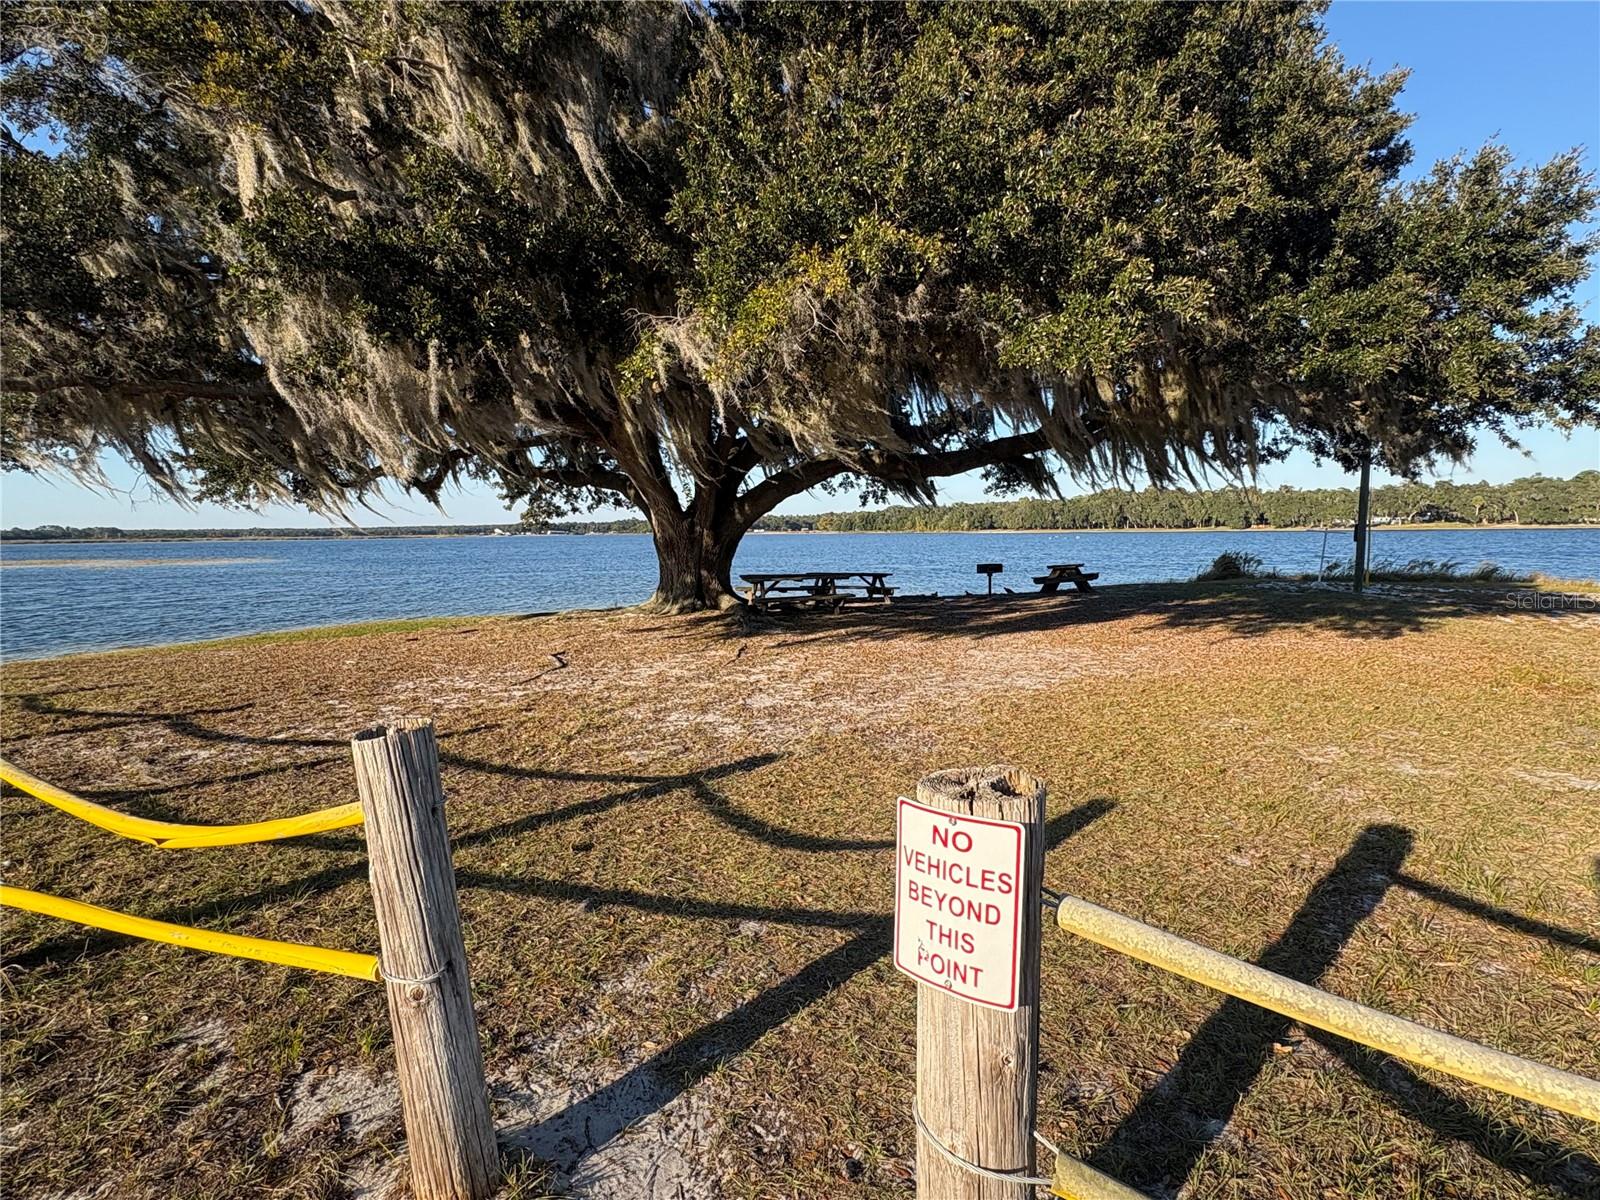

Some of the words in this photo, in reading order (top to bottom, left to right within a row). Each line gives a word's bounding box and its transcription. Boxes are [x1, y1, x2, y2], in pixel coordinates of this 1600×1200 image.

[932, 824, 973, 853] NO
[903, 845, 1013, 894] VEHICLES
[908, 879, 1001, 926] BEYOND
[926, 919, 975, 954] THIS
[917, 948, 984, 988] POINT
